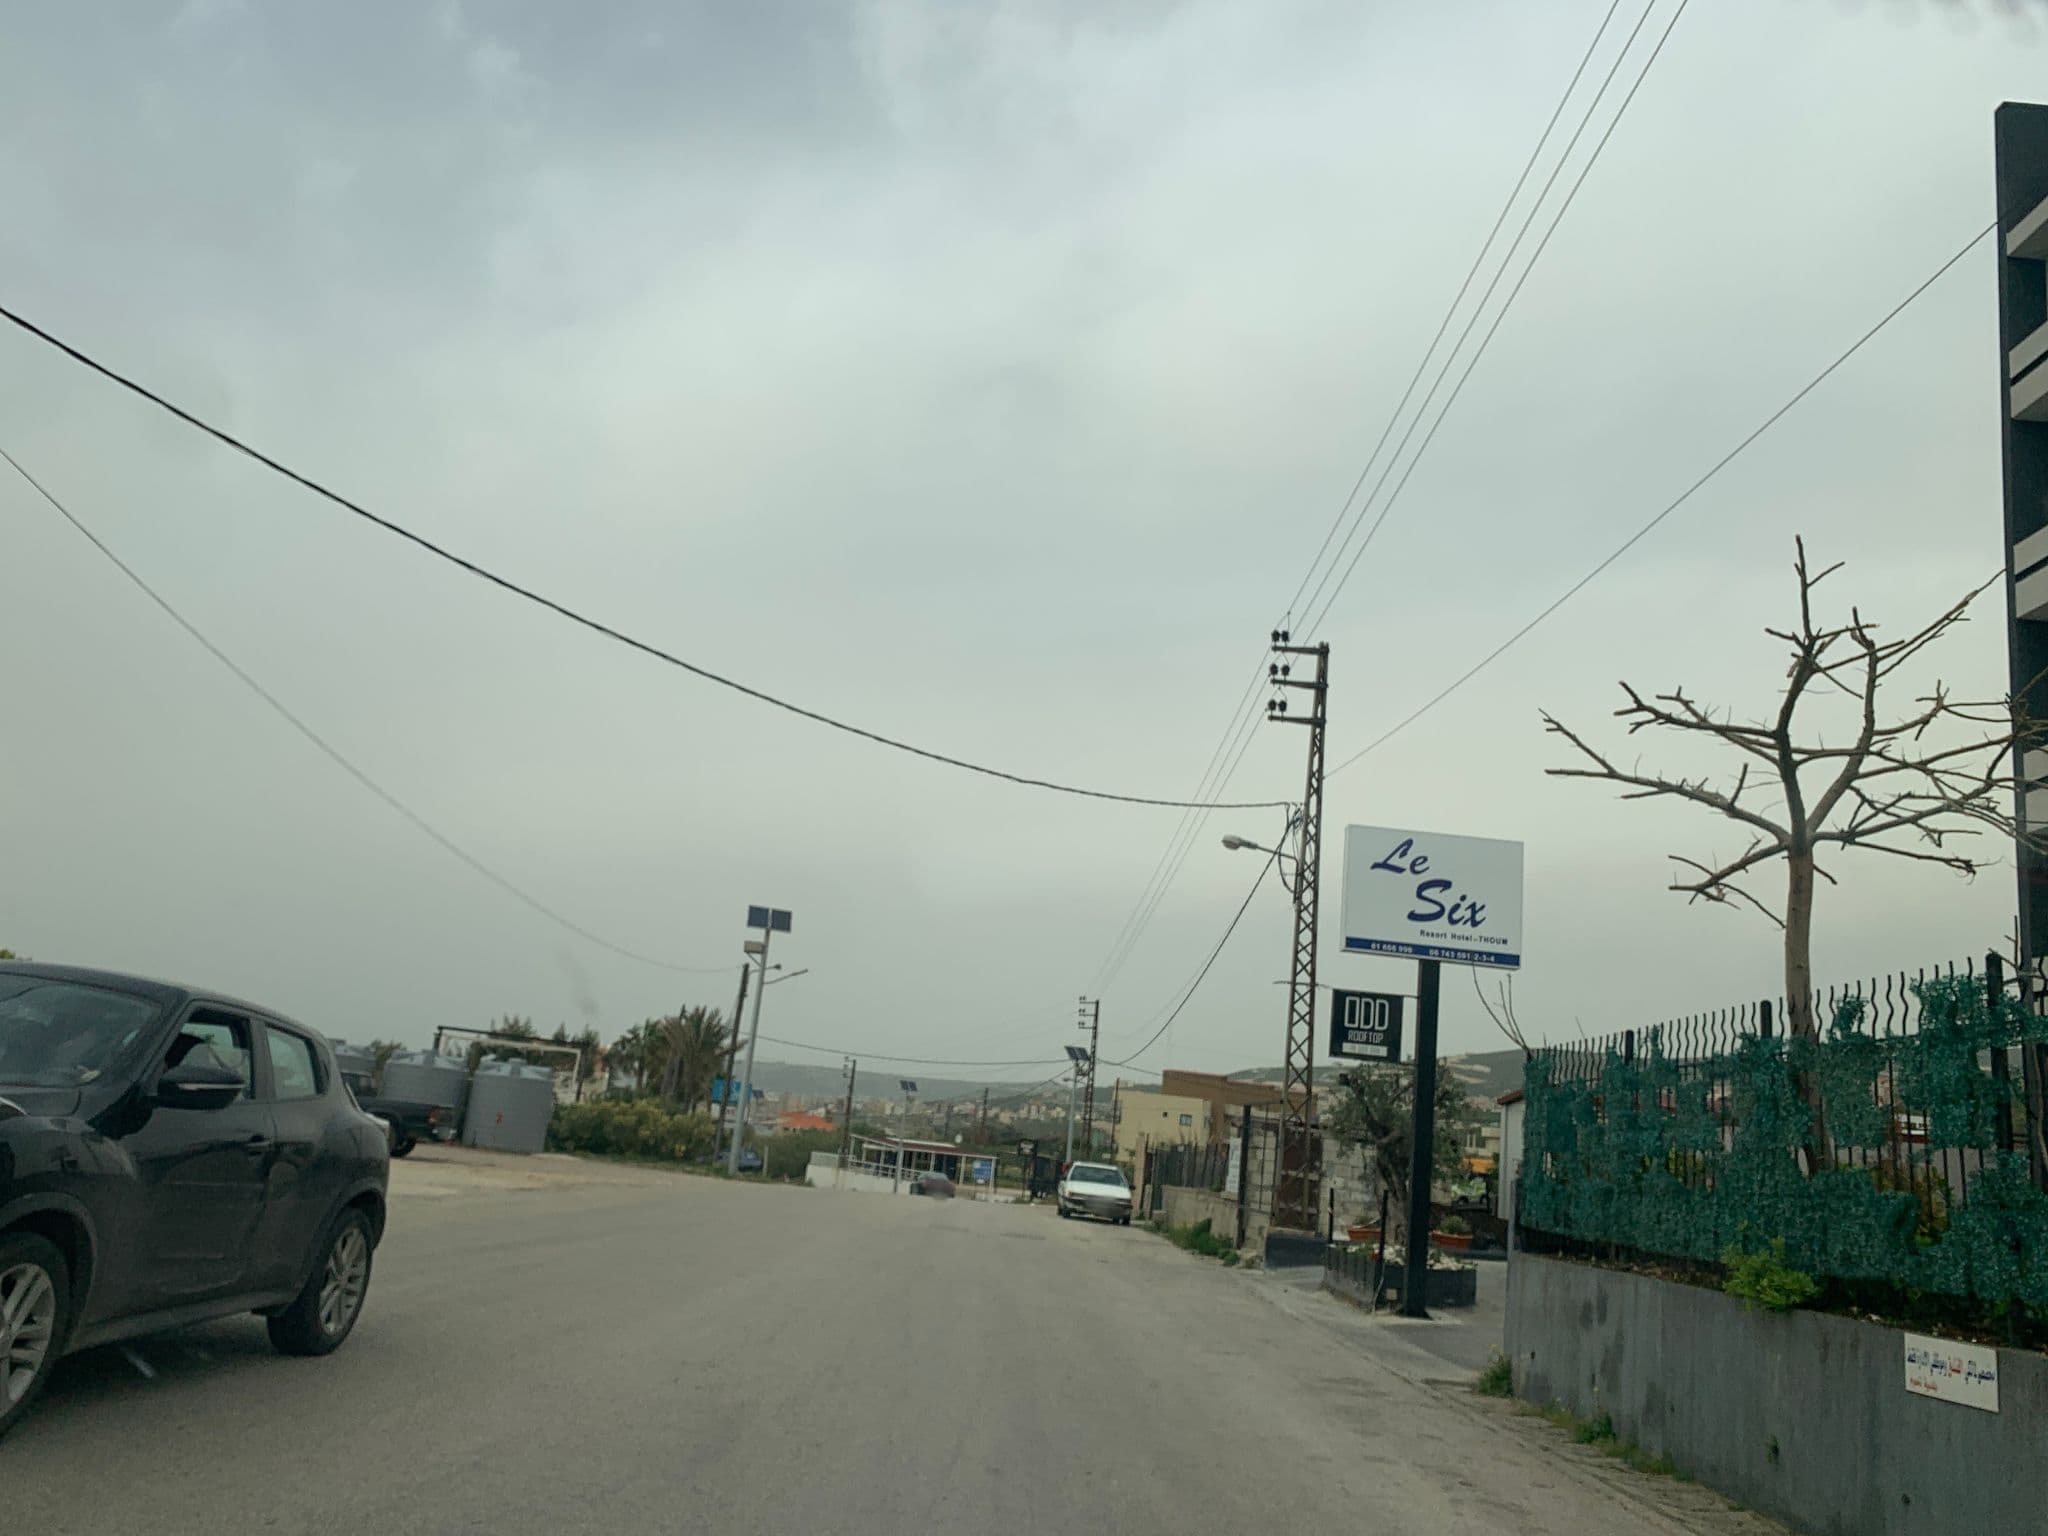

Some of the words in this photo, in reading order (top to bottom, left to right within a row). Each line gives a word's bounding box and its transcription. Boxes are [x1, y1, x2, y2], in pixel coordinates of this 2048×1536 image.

[1370, 837, 1430, 875] Le
[1407, 878, 1487, 928] Six
[1419, 929, 1448, 940] Resort
[1343, 995, 1389, 1031] ODD
[1347, 1029, 1384, 1044] ROOFTOP
